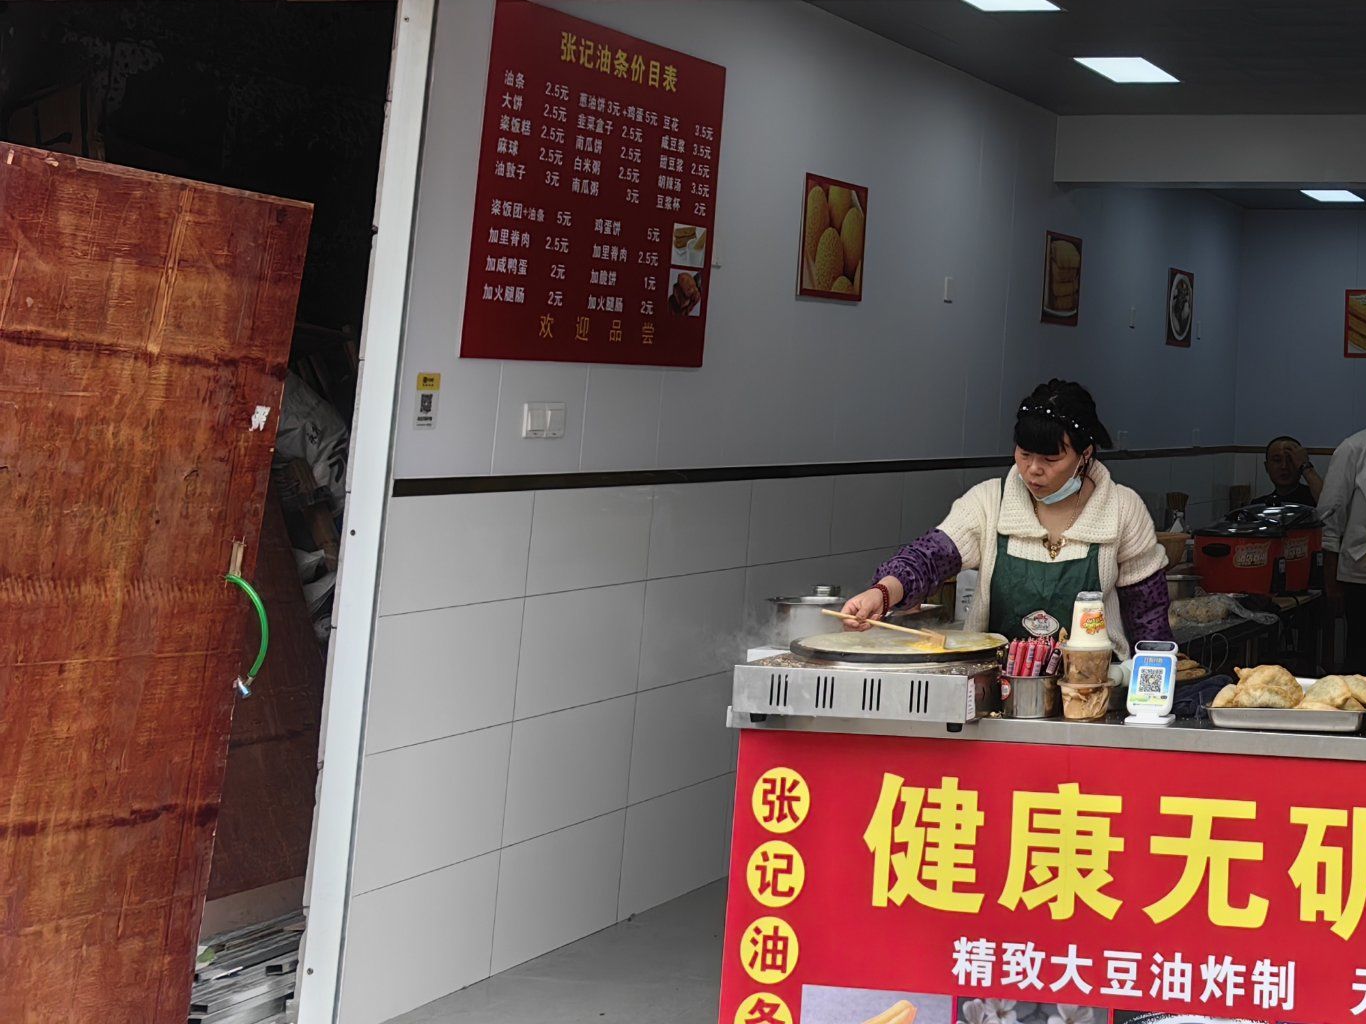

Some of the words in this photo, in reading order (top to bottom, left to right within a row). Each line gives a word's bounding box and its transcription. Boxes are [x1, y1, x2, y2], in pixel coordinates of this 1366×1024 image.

[561, 31, 678, 92] 张记油条价目表
[504, 70, 525, 89] 油条
[546, 82, 569, 100] 2.5元
[502, 92, 523, 112] 大饼
[544, 104, 567, 122] 2.5元
[541, 126, 564, 144] 2.5元
[577, 114, 613, 135] 韭菜盒子
[622, 126, 642, 143] 2.5元
[663, 115, 679, 132] 豆花
[695, 125, 713, 140] 3.5元
[497, 137, 518, 156] 麻球
[539, 148, 563, 166] 2.5元
[576, 135, 602, 154] 南瓜饼
[621, 147, 641, 163] 2.5元
[693, 144, 711, 159] 3.5元
[545, 171, 559, 187] 3元
[574, 157, 601, 175] 白米粥
[619, 167, 640, 183] 2.5元
[691, 163, 710, 178] 2.5元
[572, 178, 599, 197] 南瓜粥
[626, 189, 639, 204] 3元
[691, 182, 709, 197] 3.5元
[656, 194, 680, 211] 豆浆杯
[694, 203, 706, 217] 2元
[557, 211, 572, 226] 5元
[594, 218, 621, 236] 鸡蛋饼
[647, 227, 660, 242] 5元
[488, 227, 530, 248] 加里脊肉
[546, 236, 569, 253] 2.5元
[485, 255, 528, 275] 加咸鸭蛋
[551, 264, 566, 280] 2元
[592, 244, 627, 263] 加里脊肉
[638, 252, 658, 267] 2.5元
[483, 283, 525, 304] 加火腿肠
[548, 292, 563, 306] 2元
[644, 277, 656, 291] 1元
[588, 295, 623, 313] 加火腿肠
[641, 301, 654, 315] 2元
[539, 314, 655, 344] 欢迎品尝
[952, 936, 1295, 1010] 精致大豆油炸制
